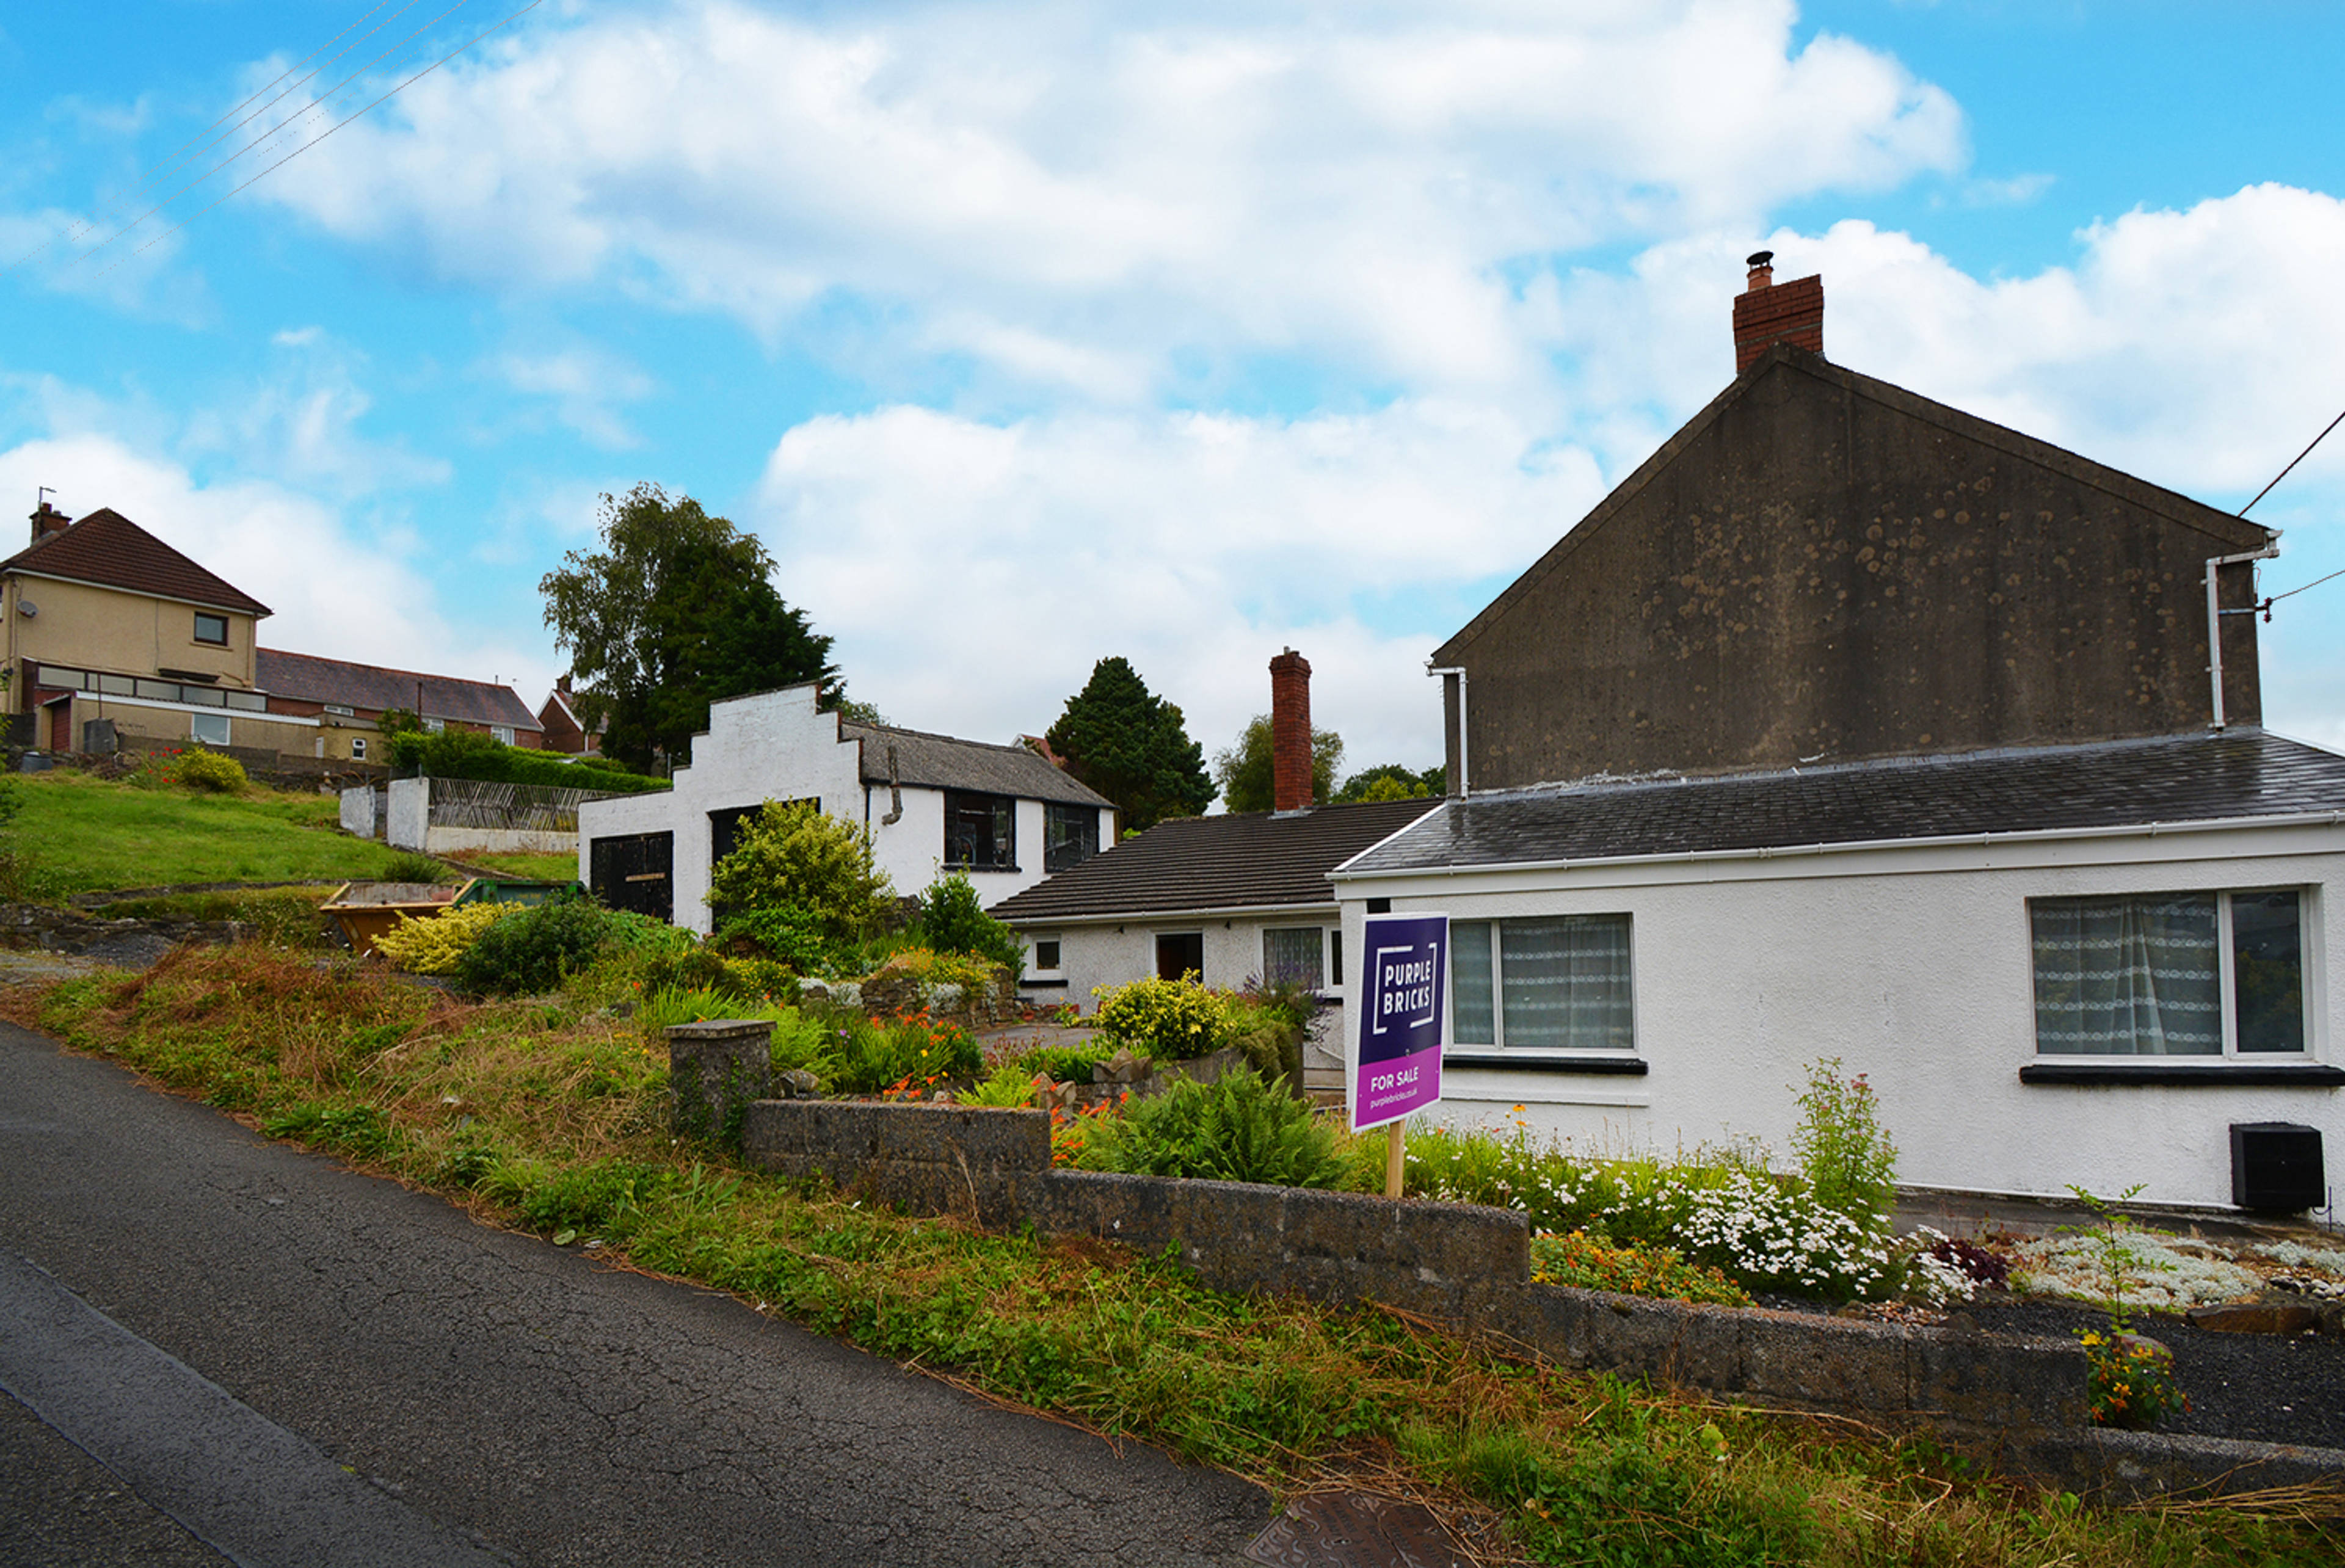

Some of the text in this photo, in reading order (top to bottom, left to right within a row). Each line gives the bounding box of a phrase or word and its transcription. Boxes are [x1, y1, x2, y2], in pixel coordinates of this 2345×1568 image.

[1385, 960, 1431, 987] PURPLE
[1383, 986, 1430, 1015] BRICKS
[1370, 1066, 1419, 1092] FOR SALE
